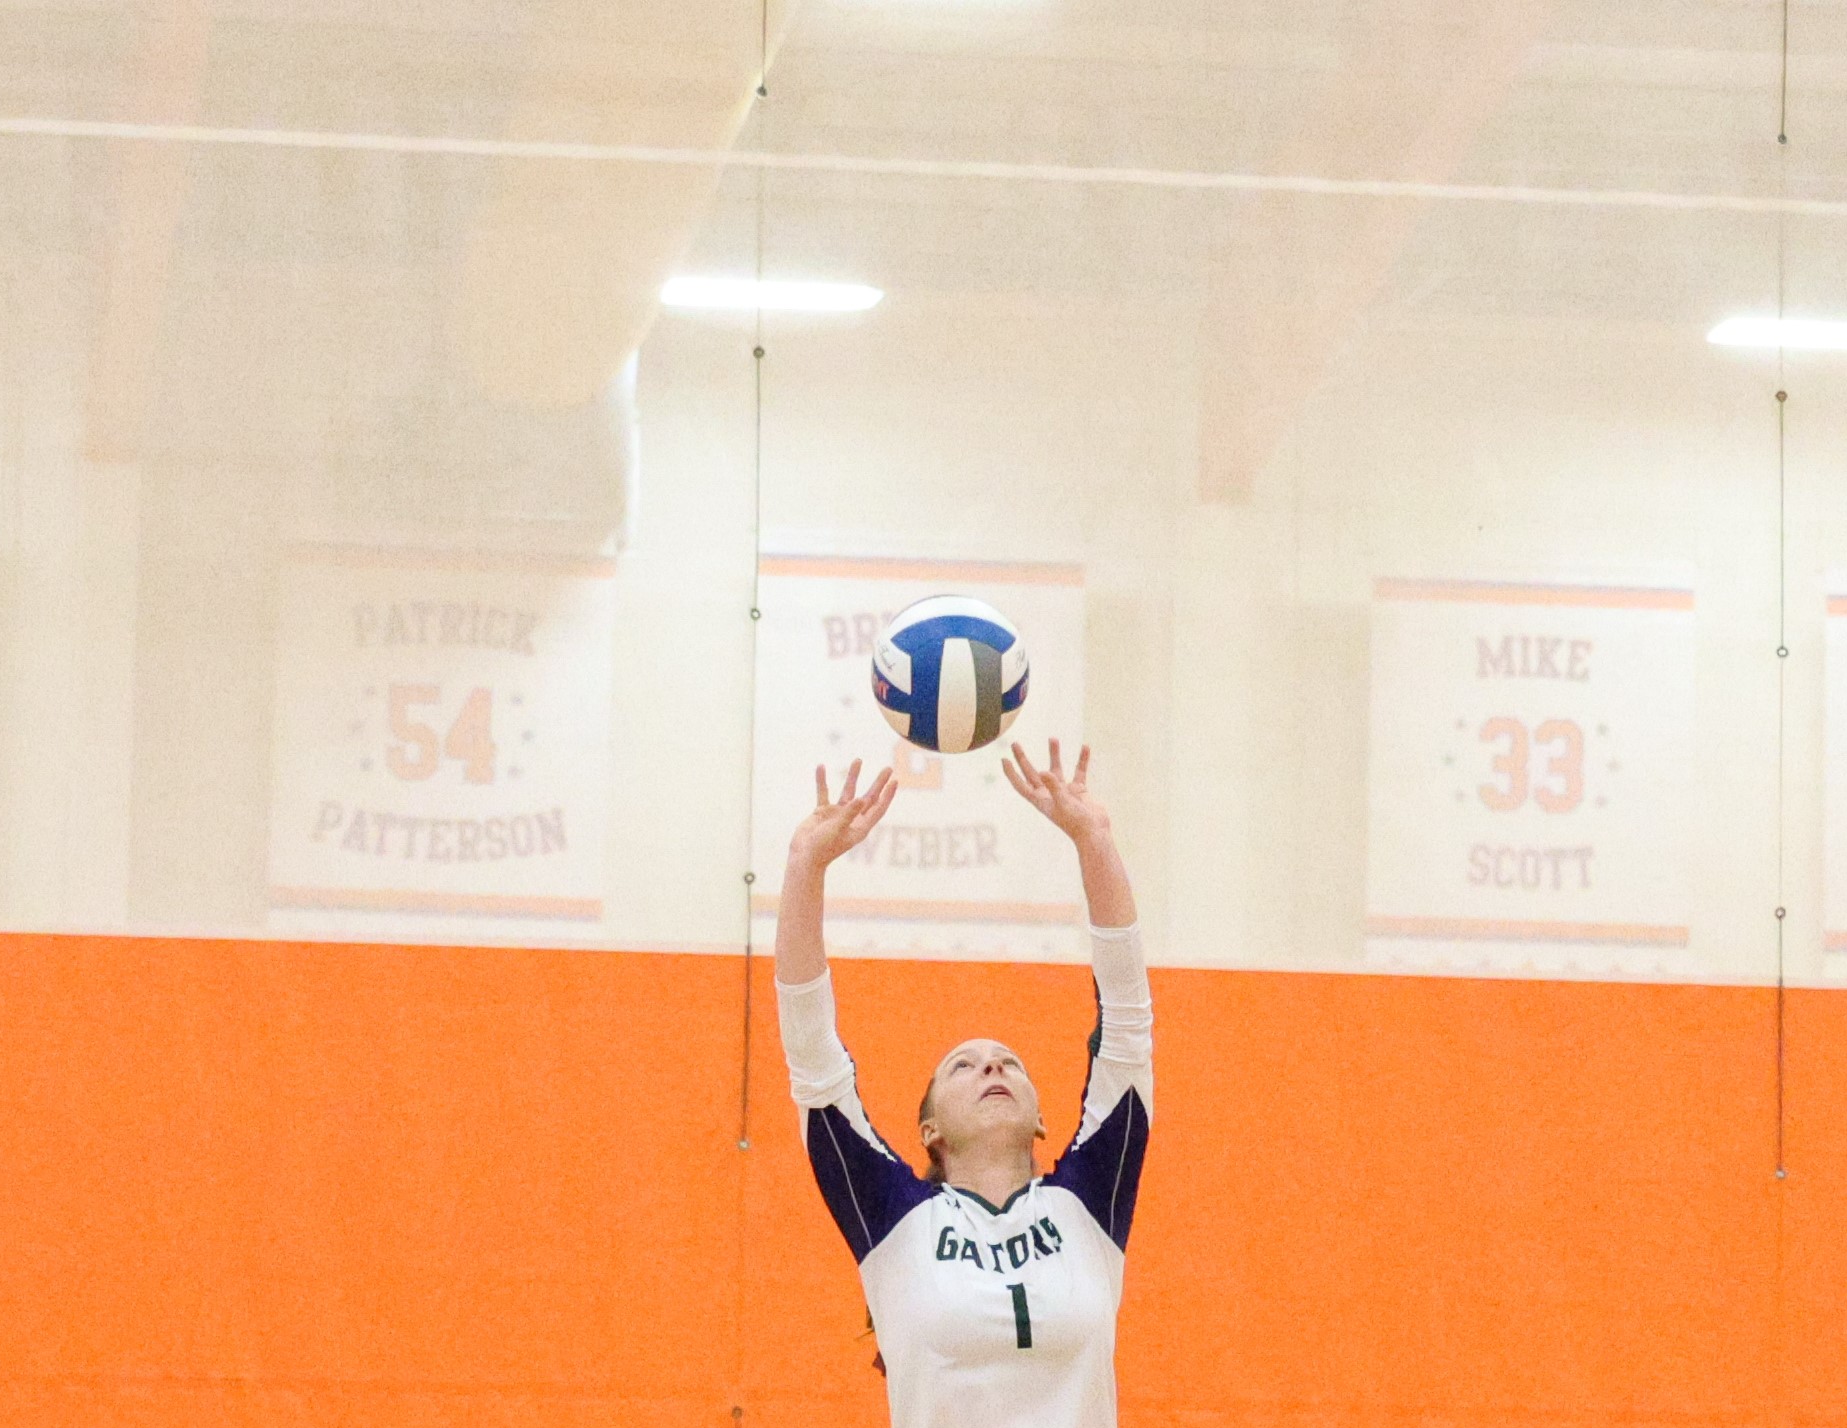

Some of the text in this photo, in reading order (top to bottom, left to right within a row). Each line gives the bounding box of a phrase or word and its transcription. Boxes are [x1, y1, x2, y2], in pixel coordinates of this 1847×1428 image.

[351, 601, 539, 657] PATRICK
[1474, 635, 1594, 683] MIKE
[385, 682, 497, 786] 54
[1476, 716, 1586, 815] 33
[310, 800, 568, 864] PATTERSON
[1467, 842, 1596, 891] SCOTT
[1006, 1282, 1033, 1349] 1
